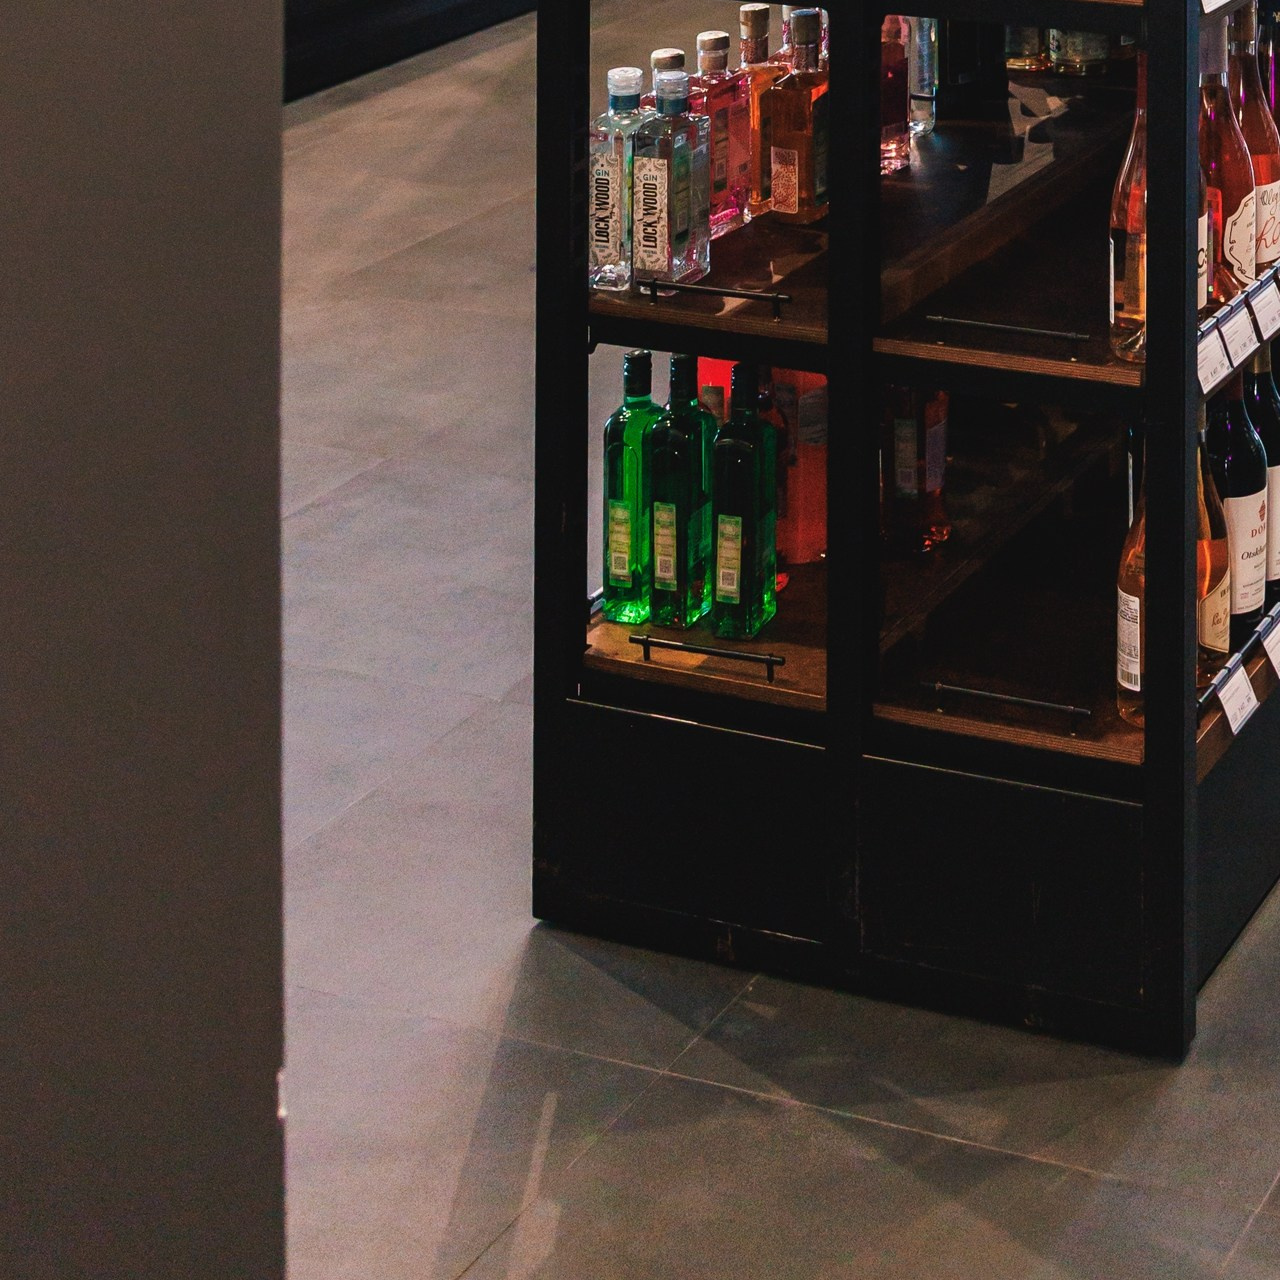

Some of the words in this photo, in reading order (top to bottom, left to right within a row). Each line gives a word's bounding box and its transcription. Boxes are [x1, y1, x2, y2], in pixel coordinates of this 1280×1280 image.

[595, 168, 609, 177] GIN
[643, 173, 658, 181] GIN
[594, 177, 610, 212] WOOD
[642, 182, 658, 217] WOOD
[594, 214, 610, 244] LOCK
[642, 219, 658, 249] LOCK
